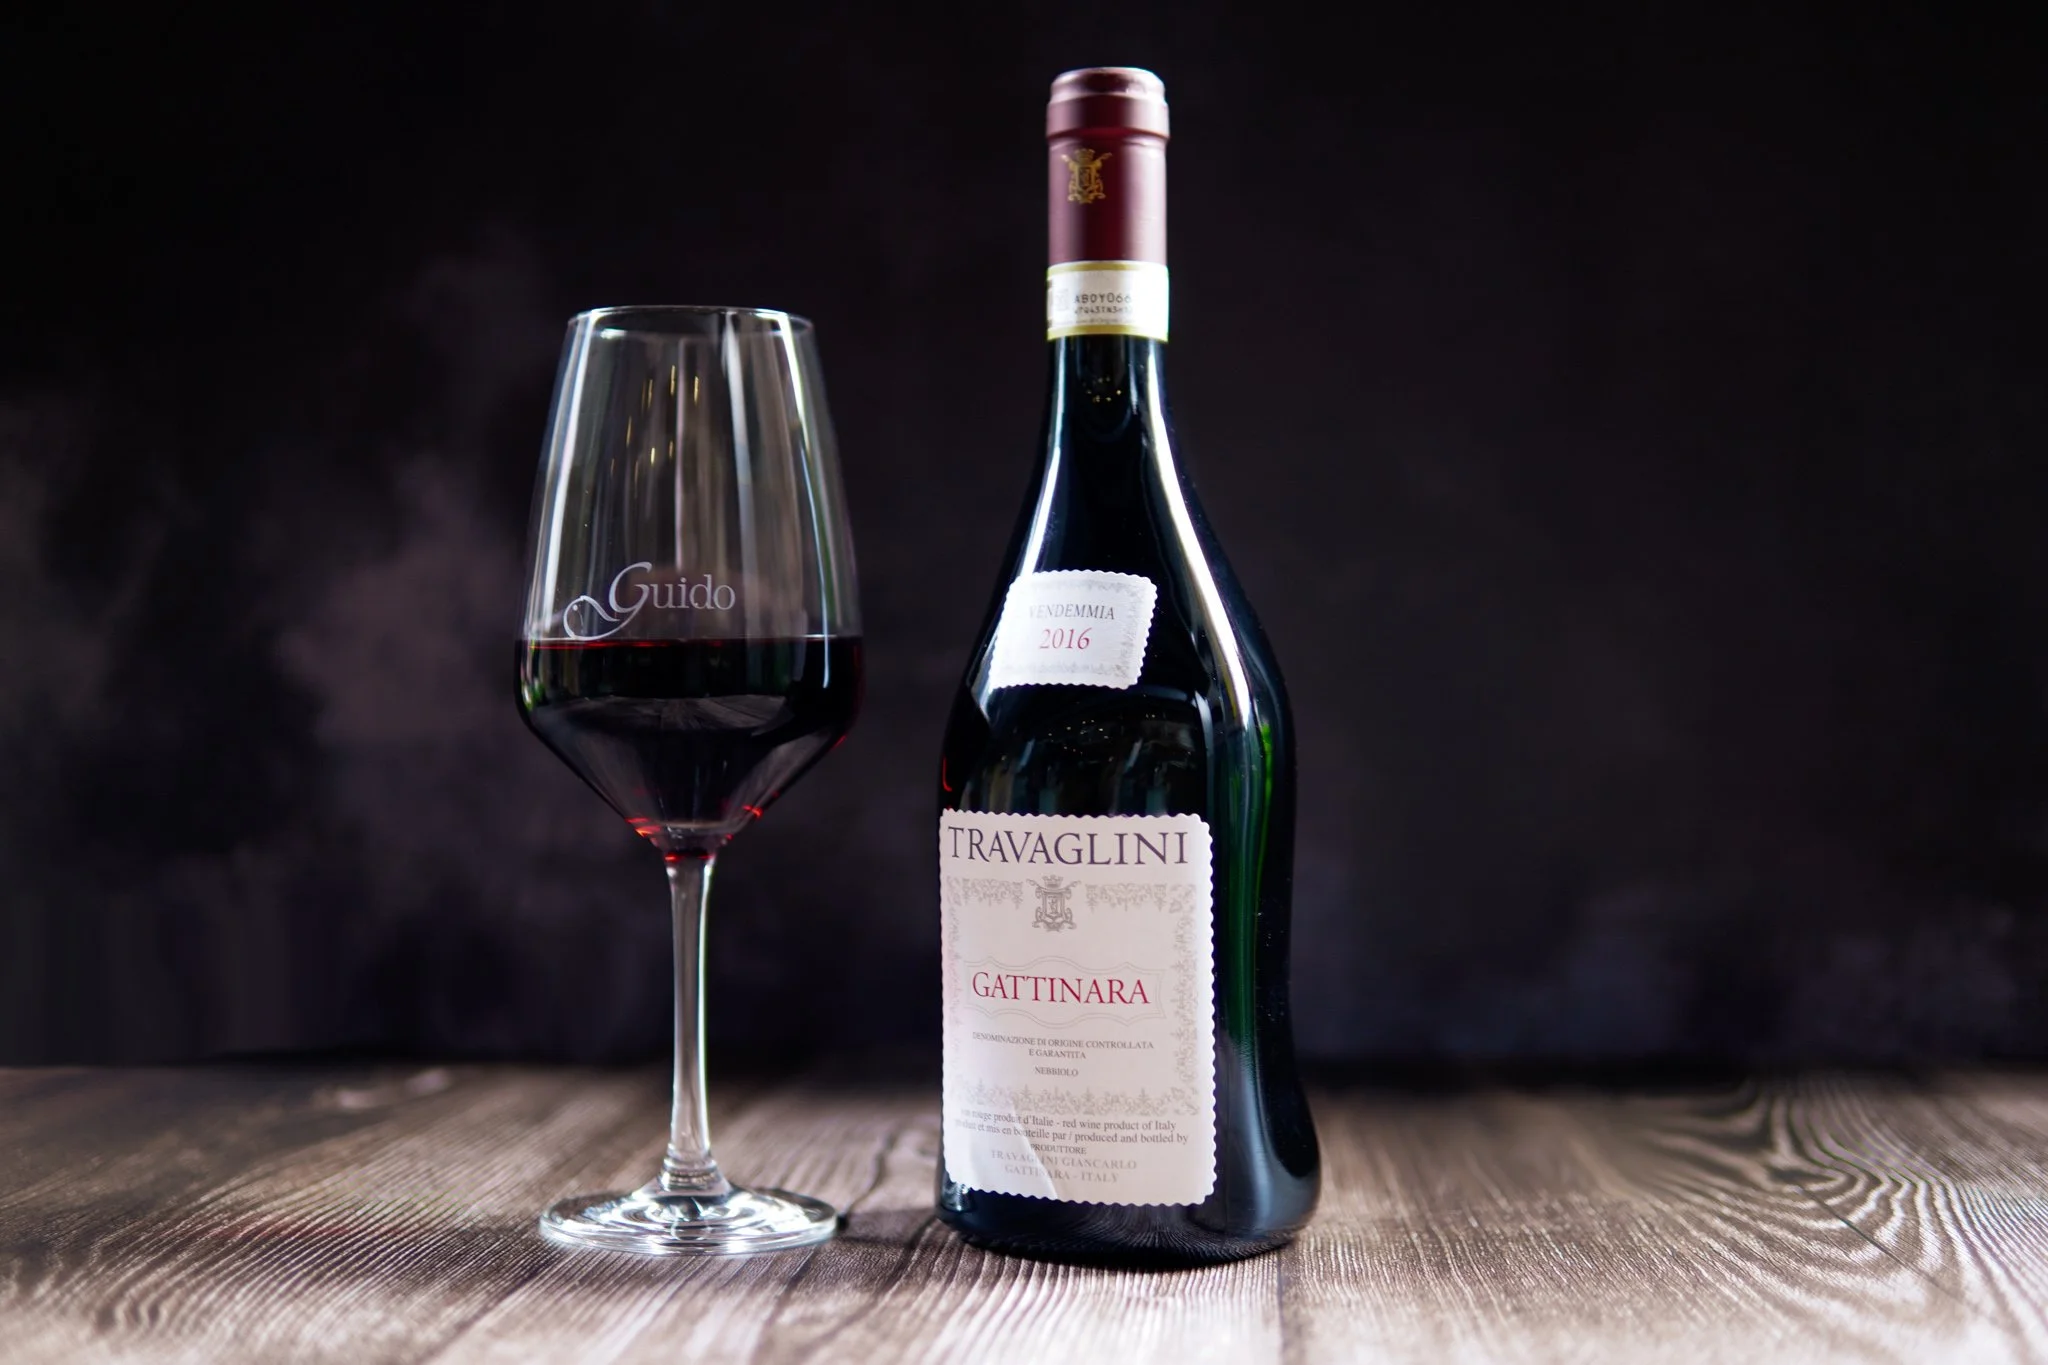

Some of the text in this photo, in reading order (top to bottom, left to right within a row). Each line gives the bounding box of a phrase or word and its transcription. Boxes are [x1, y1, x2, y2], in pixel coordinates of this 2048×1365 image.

[564, 562, 736, 641] Guido
[1029, 603, 1116, 621] VENDEMMIA
[1039, 626, 1093, 651] 2016
[947, 825, 1189, 867] TRAVAGLINI
[971, 971, 1152, 1005] GATTINARA
[972, 1031, 1155, 1050] DENOMINAZIONE DI ORIGINE CONTROLLATA
[1028, 1048, 1087, 1060] E GARANTITA
[1034, 1065, 1080, 1078] NEBBIOLO
[1023, 1114, 1055, 1127] d'Italie
[1062, 1119, 1077, 1129] red
[1079, 1119, 1101, 1130] wine
[1103, 1120, 1140, 1132] product
[1142, 1121, 1154, 1131] of
[1155, 1121, 1177, 1133] Italy
[1001, 1127, 1013, 1135] en
[1052, 1131, 1067, 1142] par
[1074, 1132, 1118, 1143] produced
[1120, 1133, 1138, 1144] and
[1140, 1132, 1174, 1144] bottled
[1176, 1133, 1189, 1146] by
[1030, 1143, 1087, 1155] PRODUTTORE
[991, 1149, 1138, 1170] TRAVAGINI GIANCARLO
[1004, 1164, 1071, 1180] GATTIARA
[1080, 1171, 1120, 1183] ITALY
